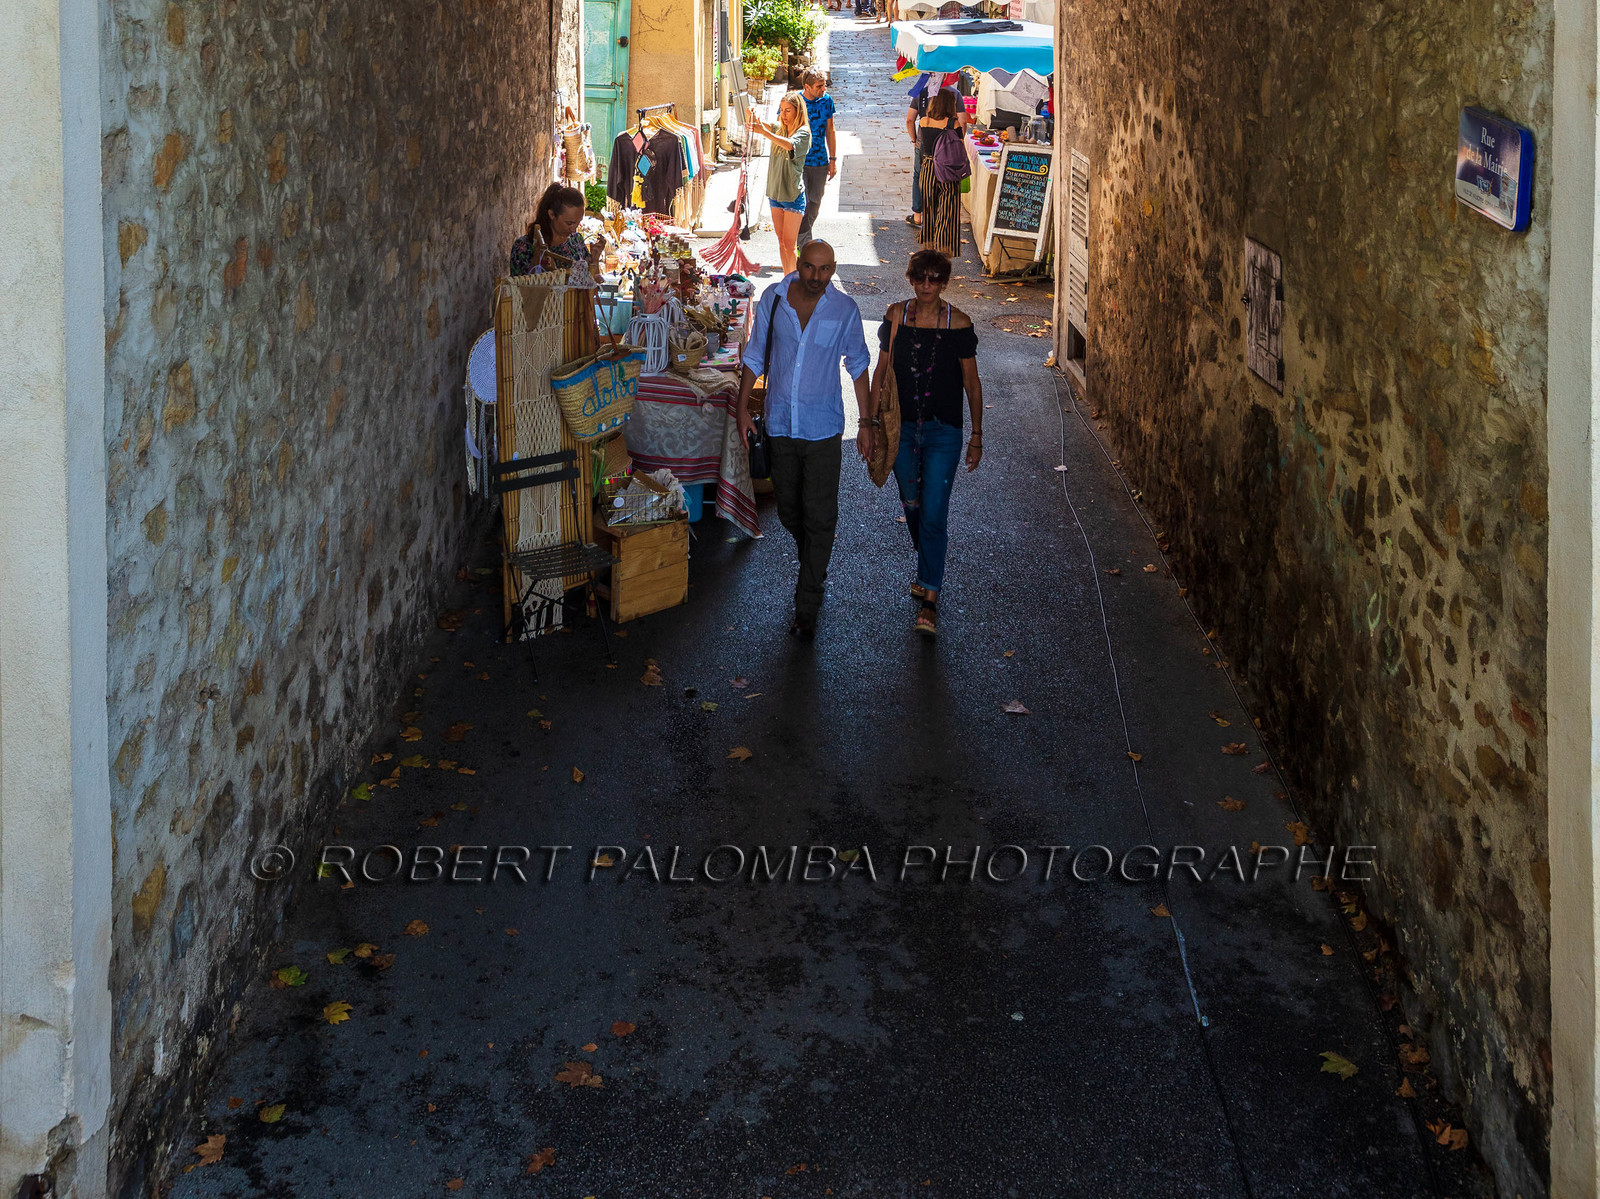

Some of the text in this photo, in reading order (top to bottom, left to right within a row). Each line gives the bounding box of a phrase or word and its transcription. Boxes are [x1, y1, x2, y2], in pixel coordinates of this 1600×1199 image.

[1480, 126, 1496, 148] Rue
[1466, 144, 1508, 177] de la Mairie
[582, 361, 638, 418] aloha
